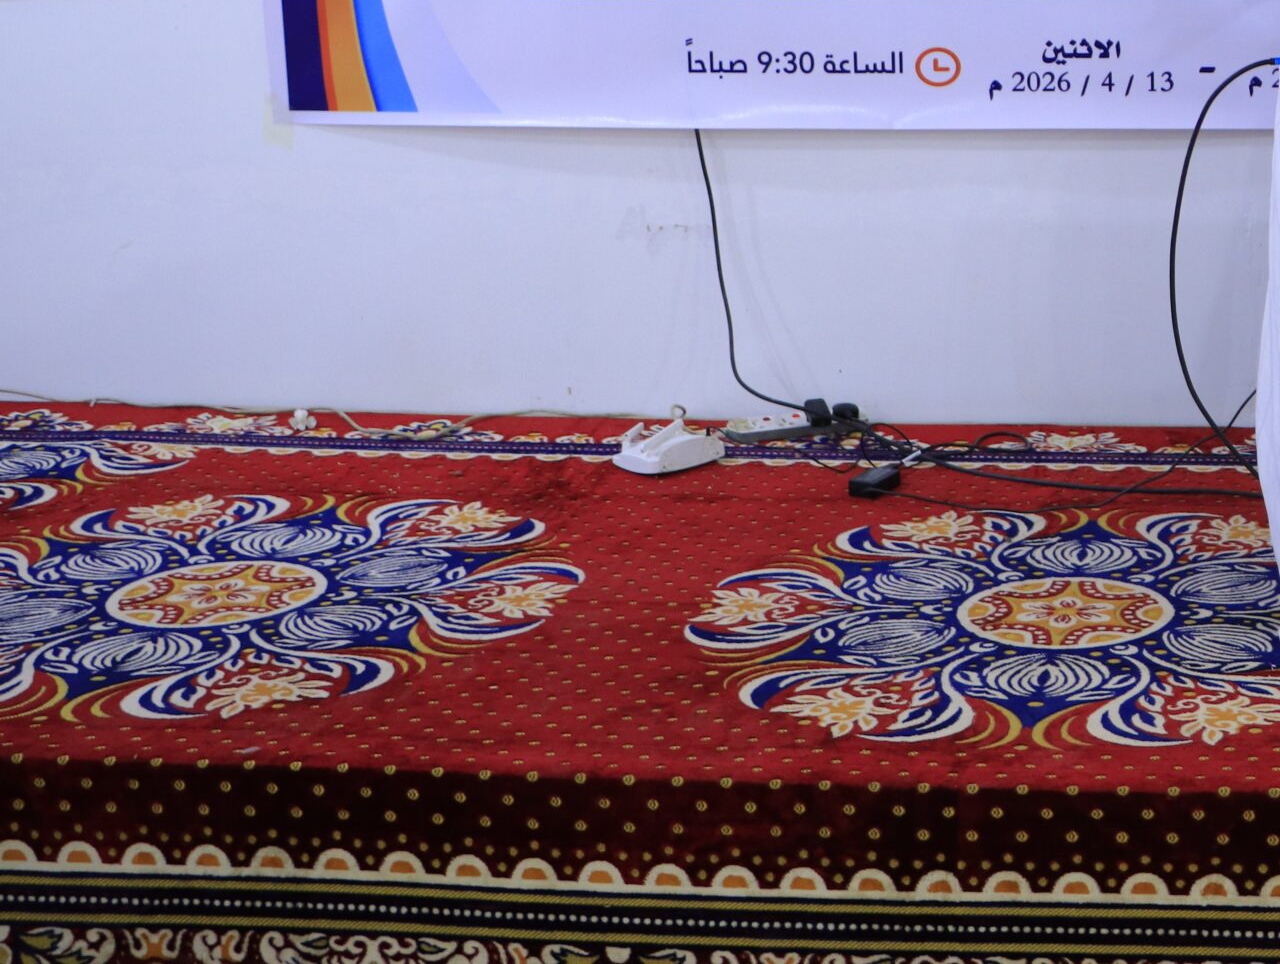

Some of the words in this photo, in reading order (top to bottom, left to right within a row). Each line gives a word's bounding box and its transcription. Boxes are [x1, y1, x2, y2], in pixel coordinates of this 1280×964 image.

[757, 50, 815, 75] 9:30
[823, 50, 904, 75] الساعة
[1041, 38, 1121, 65] الاثنين
[988, 79, 1003, 101] م
[1011, 70, 1072, 93] 2026
[1101, 71, 1115, 93] 4
[1147, 70, 1175, 93] 13
